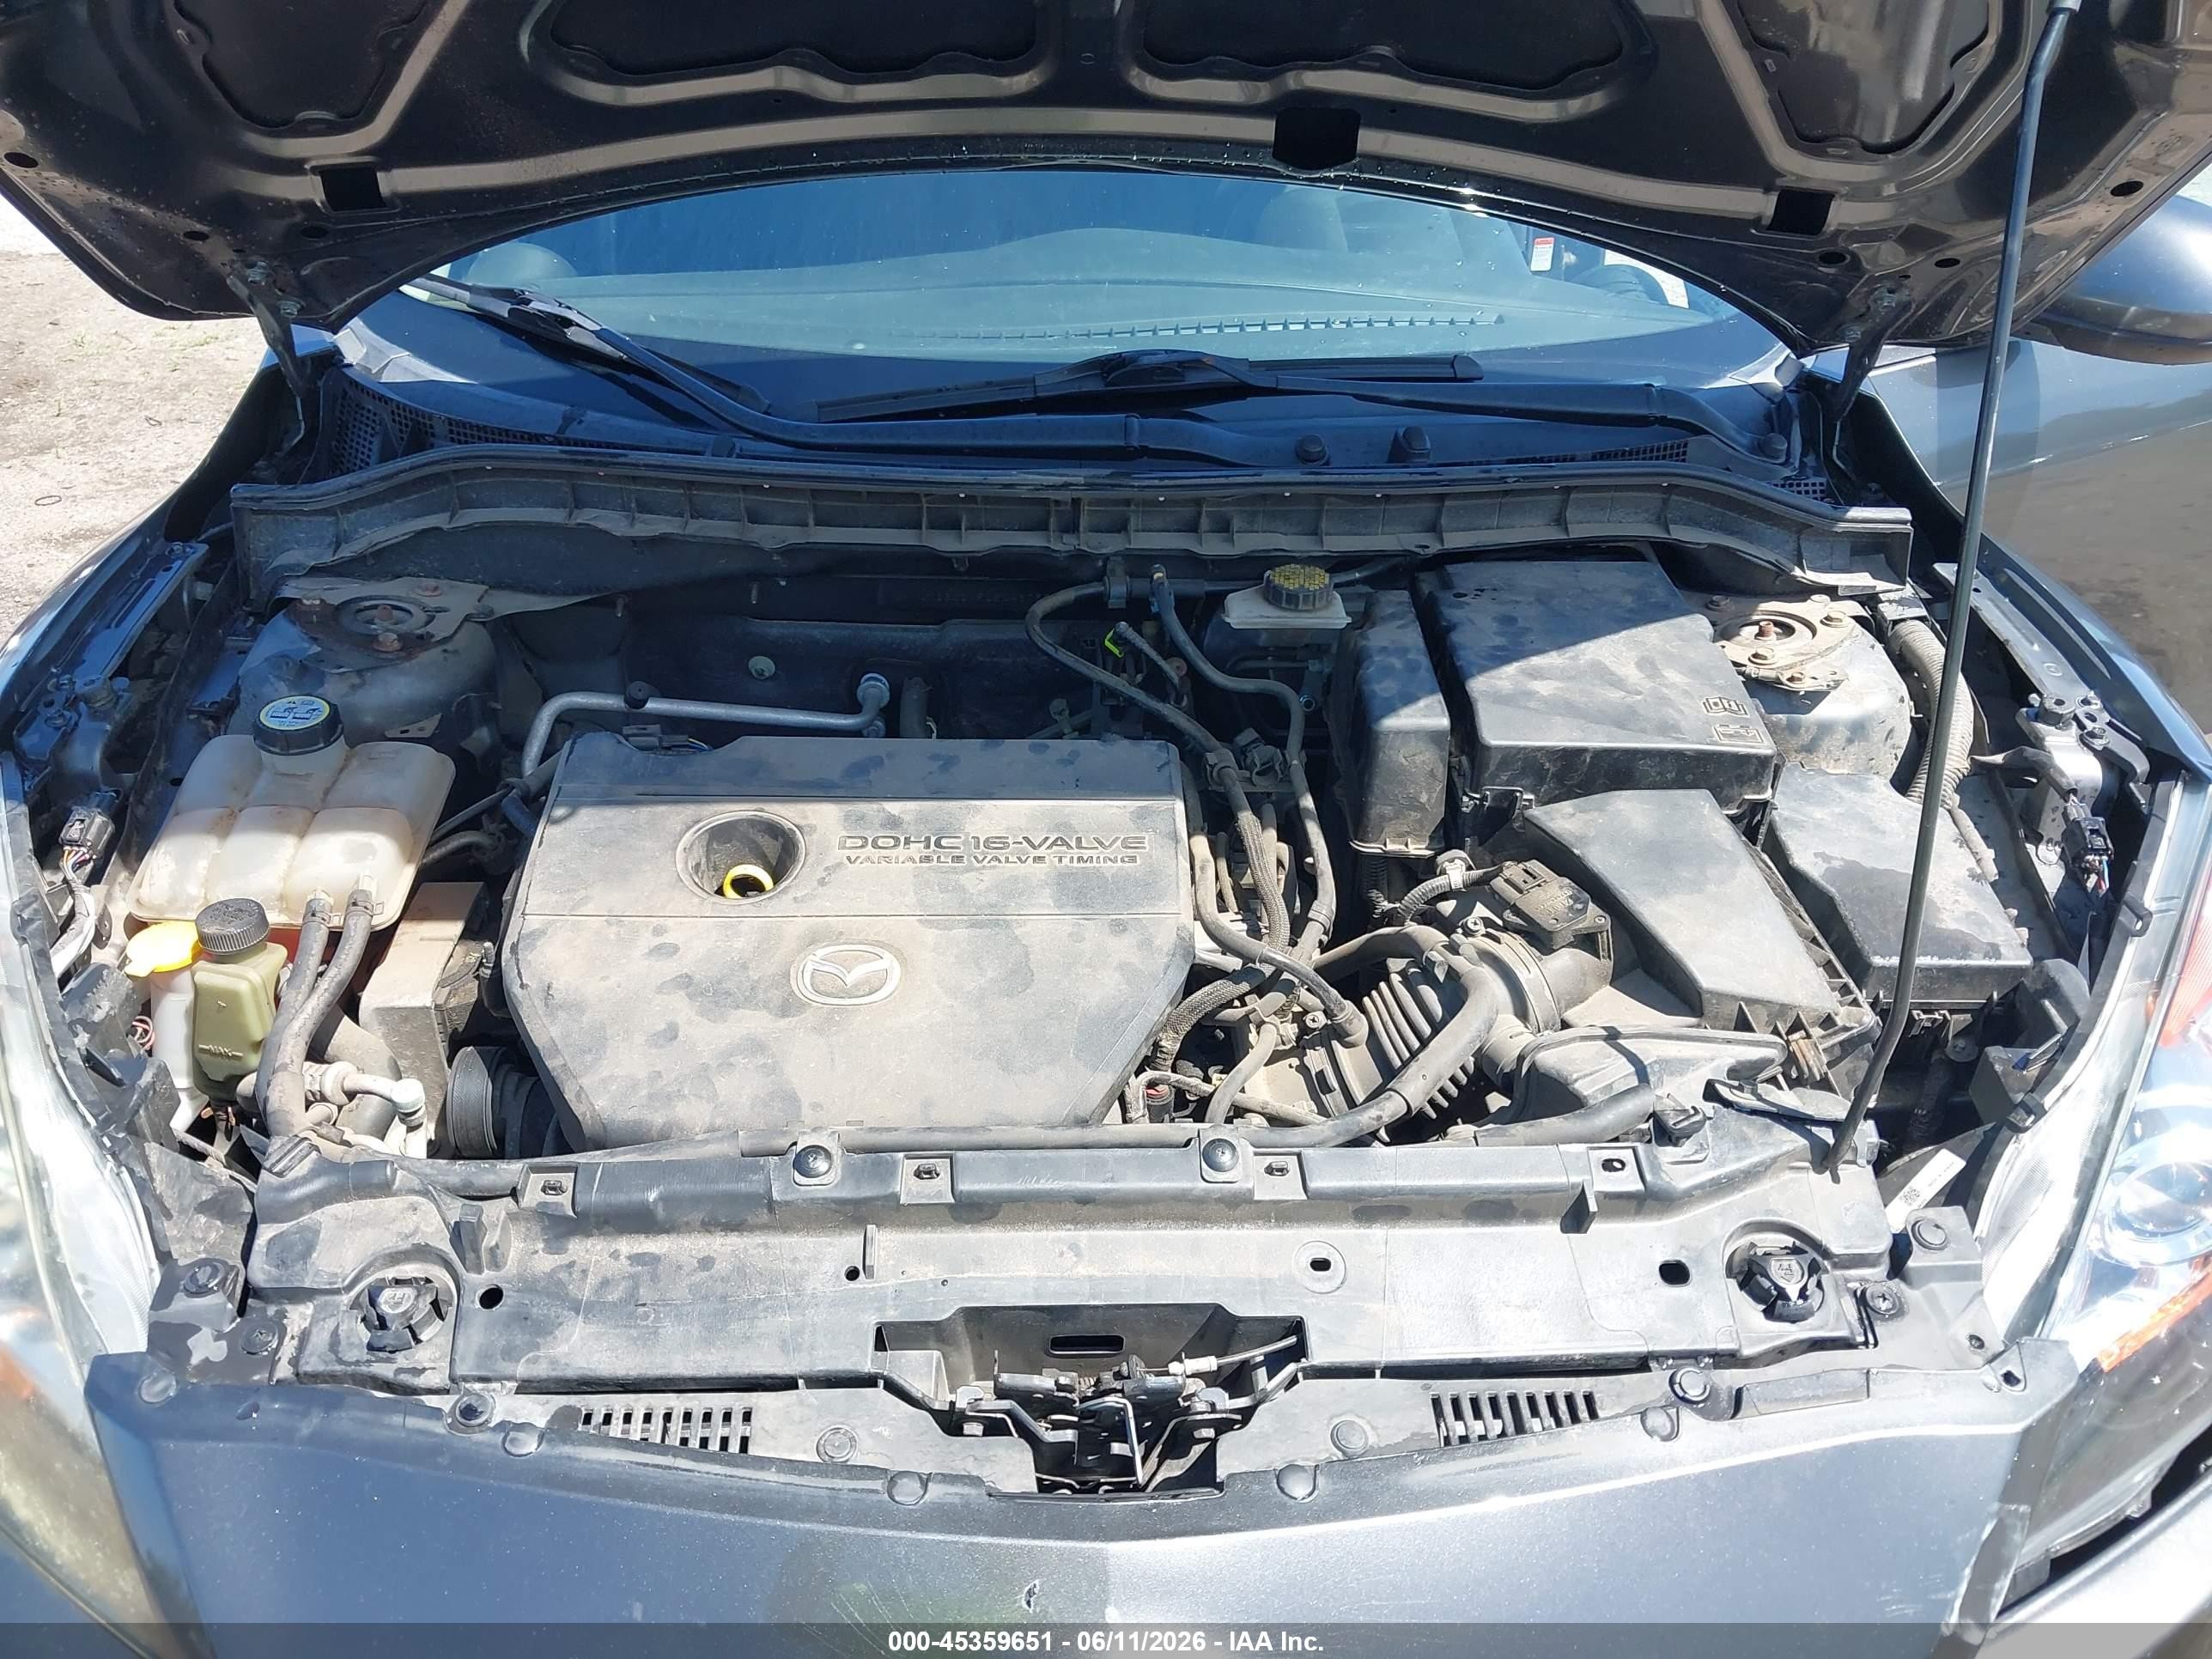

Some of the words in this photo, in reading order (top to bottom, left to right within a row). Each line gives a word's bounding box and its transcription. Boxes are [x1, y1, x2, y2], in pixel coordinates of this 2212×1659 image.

[838, 835, 963, 851] DOHC
[970, 835, 1147, 851] 16-VALVE
[846, 854, 966, 866] VARIABLE
[973, 854, 1047, 866] VALVE
[1053, 854, 1138, 866] TIMING
